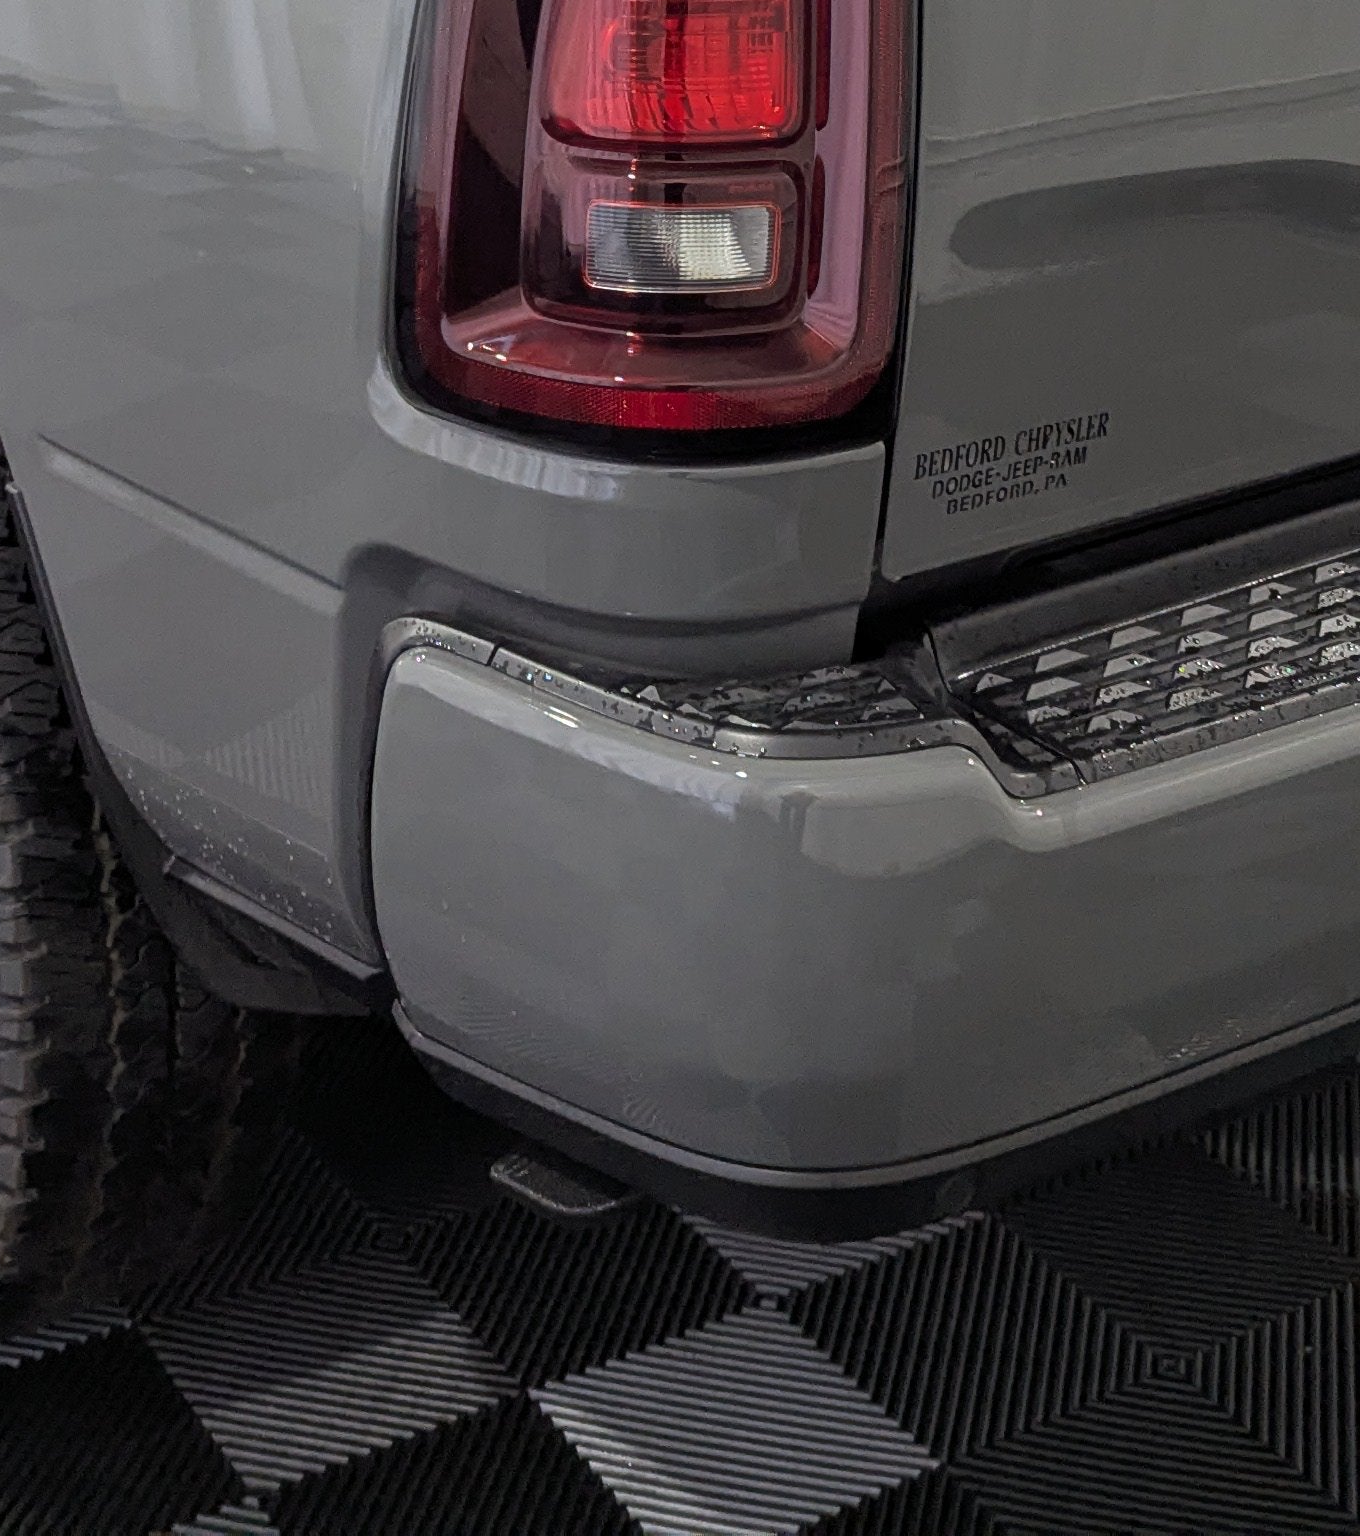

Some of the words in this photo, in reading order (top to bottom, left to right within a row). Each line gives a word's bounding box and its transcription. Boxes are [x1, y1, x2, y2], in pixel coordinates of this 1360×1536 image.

[913, 435, 1006, 480] BEDFORD
[1014, 412, 1110, 457] CHRYSLER
[1044, 472, 1068, 490] PA
